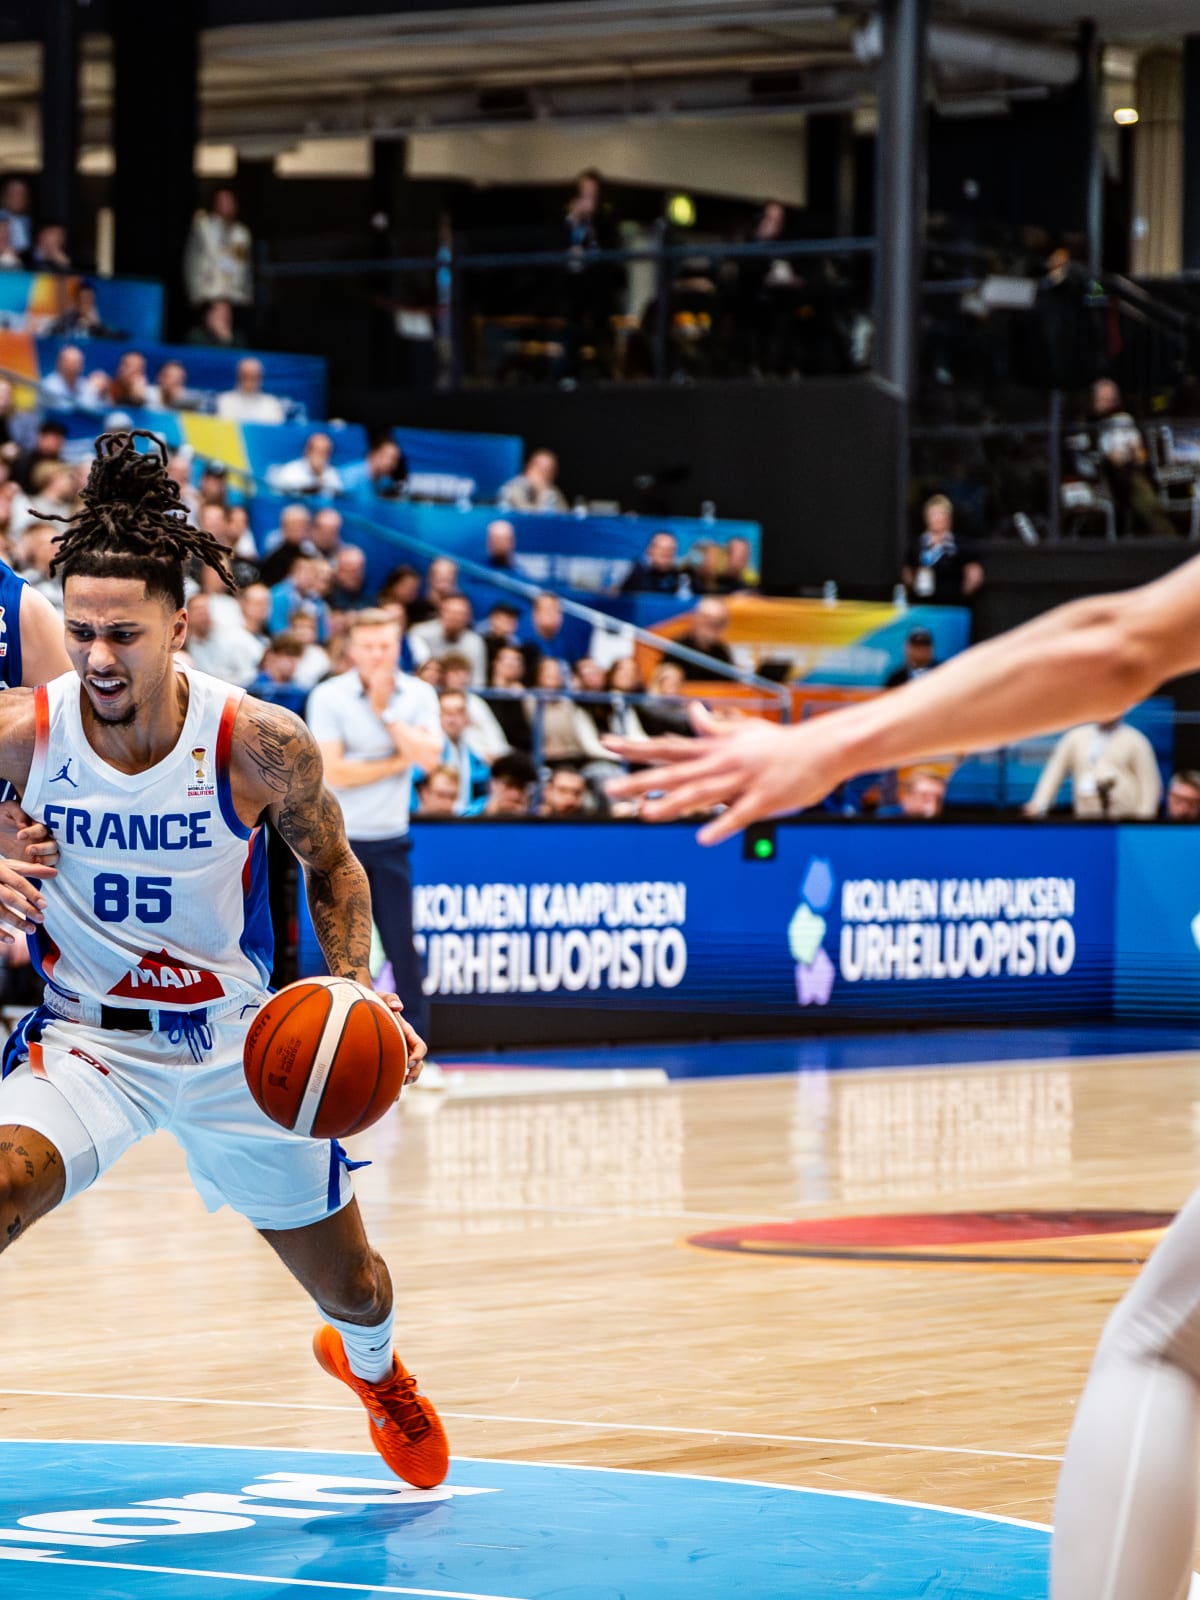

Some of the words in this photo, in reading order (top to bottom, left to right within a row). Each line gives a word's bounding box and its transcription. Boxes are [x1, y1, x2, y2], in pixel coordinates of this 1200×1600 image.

[44, 804, 212, 850] FRANCE
[93, 872, 172, 924] 85
[412, 882, 527, 932] KOLMEN
[528, 880, 687, 929] KAMPUKSEN
[841, 879, 939, 922] KOLMEN
[939, 877, 1076, 919] KAMPUKSEN
[413, 926, 688, 997] URHEILUOPISTO
[840, 918, 1076, 983] URHEILUOPISTO
